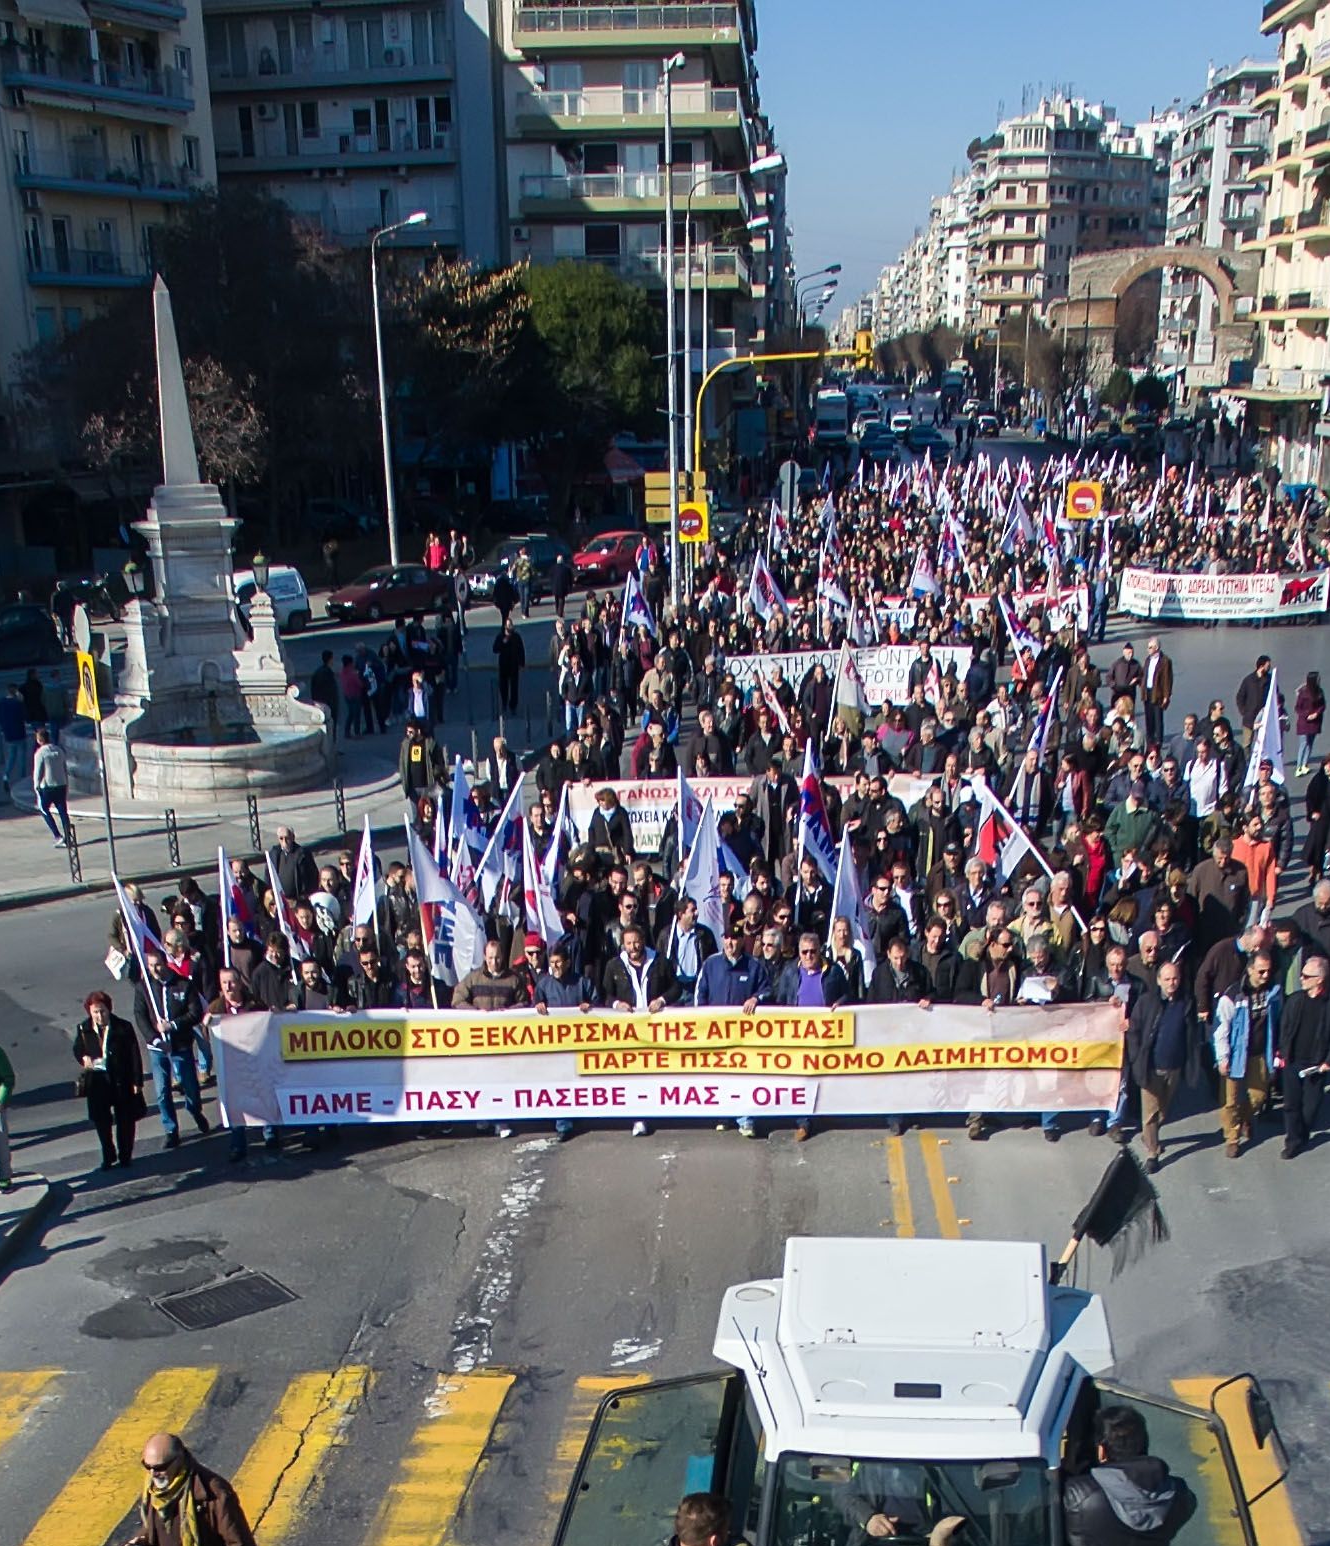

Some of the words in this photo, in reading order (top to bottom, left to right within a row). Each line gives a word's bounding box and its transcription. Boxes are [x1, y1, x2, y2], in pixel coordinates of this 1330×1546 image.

[289, 1028, 403, 1054] ΜΠΛΟΚΟ
[411, 1028, 460, 1049] ΣΤΟ
[470, 1022, 639, 1048] ΞΕΚΛΗΡΙΣΜΑ
[648, 1021, 698, 1043] ΤΗΣ
[707, 1018, 844, 1042] ΑΓΡΟΤΙΑΣ!
[583, 1051, 670, 1070] ΠΑΡΤΕ
[680, 1051, 747, 1069] ΠΙΣΩ
[761, 1052, 792, 1070] ΤΟ
[803, 1051, 885, 1071] ΝΟΜΟ
[894, 1046, 1078, 1068] ΛΑΙΜΗΤΟΜΟ!
[289, 1092, 372, 1115] ΠΑΜΕ
[405, 1090, 481, 1111] ΠΑΣΥ
[514, 1087, 626, 1109] ΠΑΣΕΒΕ
[660, 1086, 720, 1105] ΜΑΣ
[752, 1086, 806, 1106] ΟΓΕ
